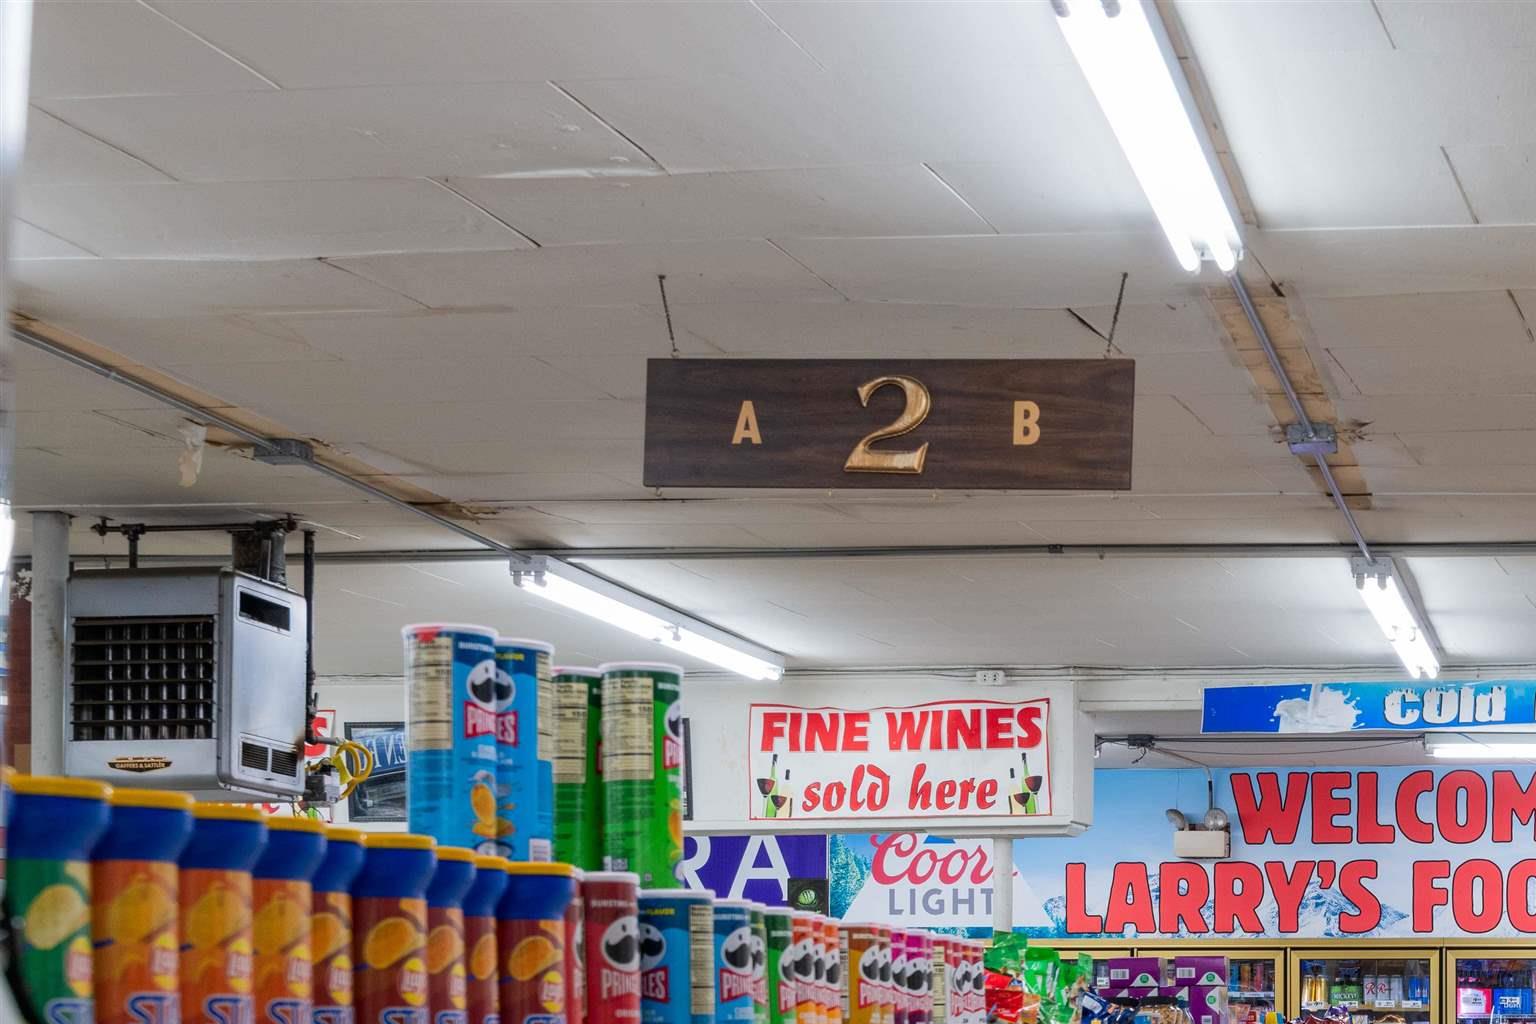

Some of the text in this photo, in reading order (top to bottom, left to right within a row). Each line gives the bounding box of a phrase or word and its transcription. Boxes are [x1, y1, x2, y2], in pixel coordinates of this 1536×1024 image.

[732, 375, 1041, 474] A 2 B
[760, 706, 1042, 752] FINE WINES
[801, 762, 998, 812] sold here
[869, 832, 1000, 886] Coor
[888, 887, 993, 917] LIGHT
[1065, 859, 1382, 934] LARRY'S
